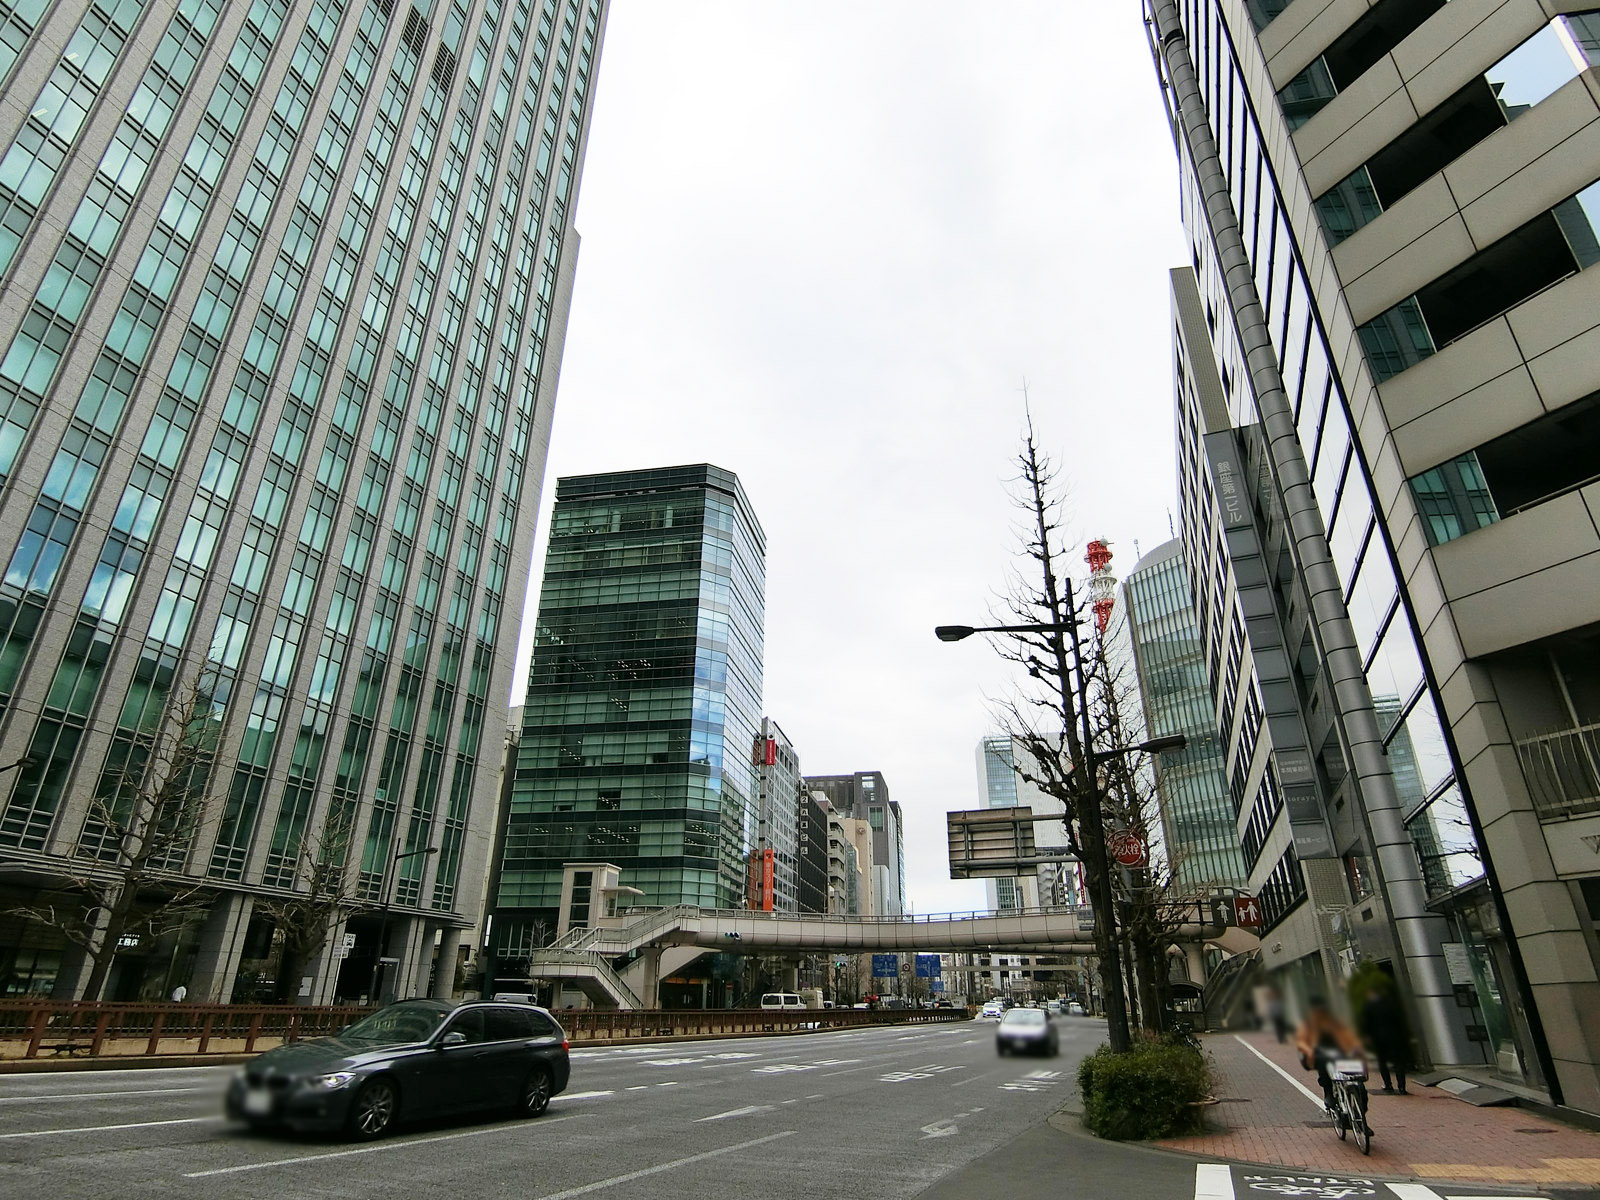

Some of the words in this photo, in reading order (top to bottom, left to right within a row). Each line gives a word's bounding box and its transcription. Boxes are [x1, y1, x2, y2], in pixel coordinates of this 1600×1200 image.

[1216, 461, 1242, 524] 銀座第一ビル
